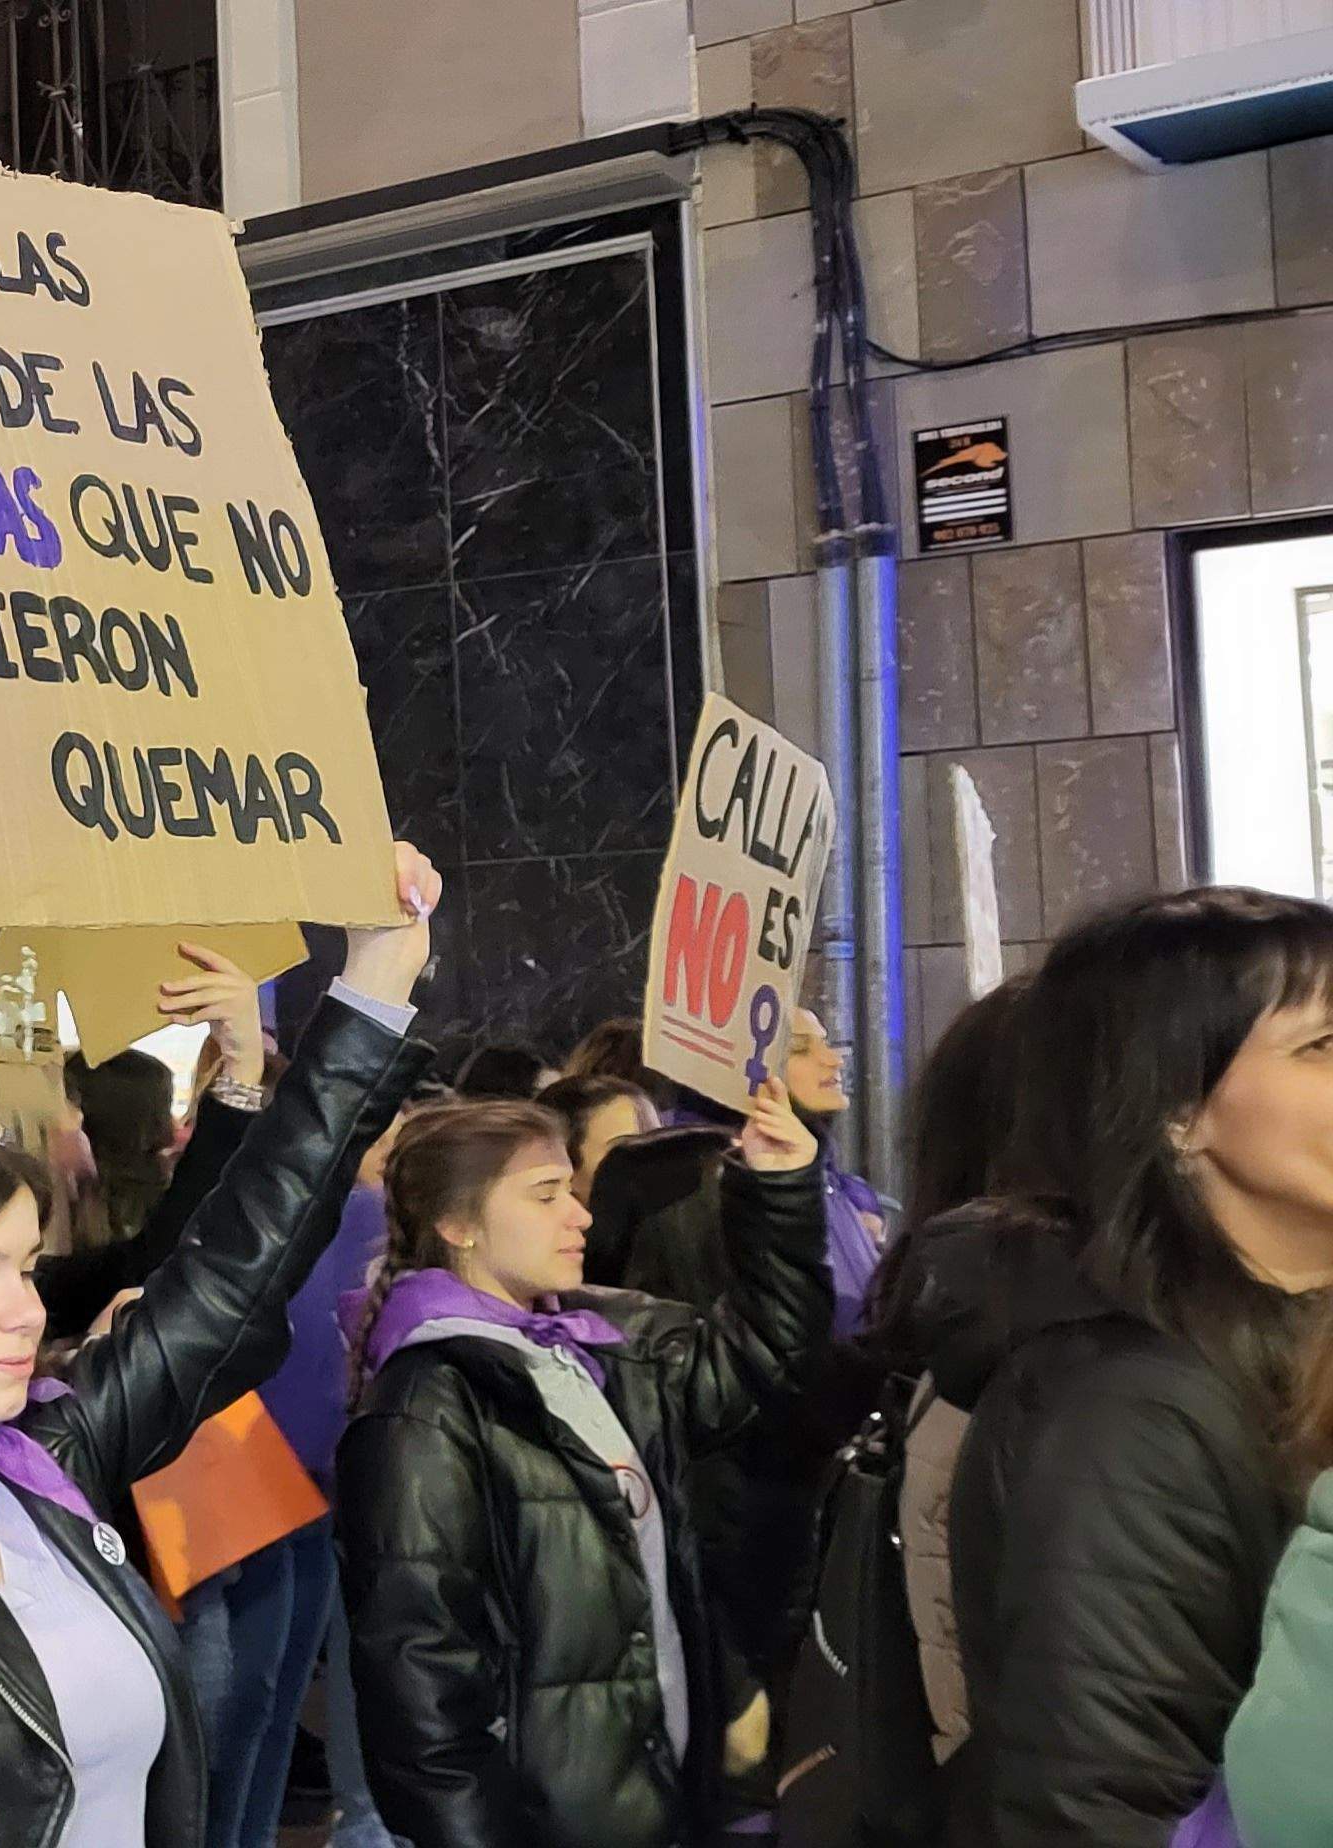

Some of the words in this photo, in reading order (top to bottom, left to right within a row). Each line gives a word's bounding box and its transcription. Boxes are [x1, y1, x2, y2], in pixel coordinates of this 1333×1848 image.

[91, 360, 202, 457] LAS
[924, 466, 1004, 489] second
[69, 474, 213, 583] QUE
[227, 502, 313, 599] NO
[51, 731, 342, 844] QUEMAR
[663, 872, 750, 1009] NO
[758, 886, 801, 970] ES
